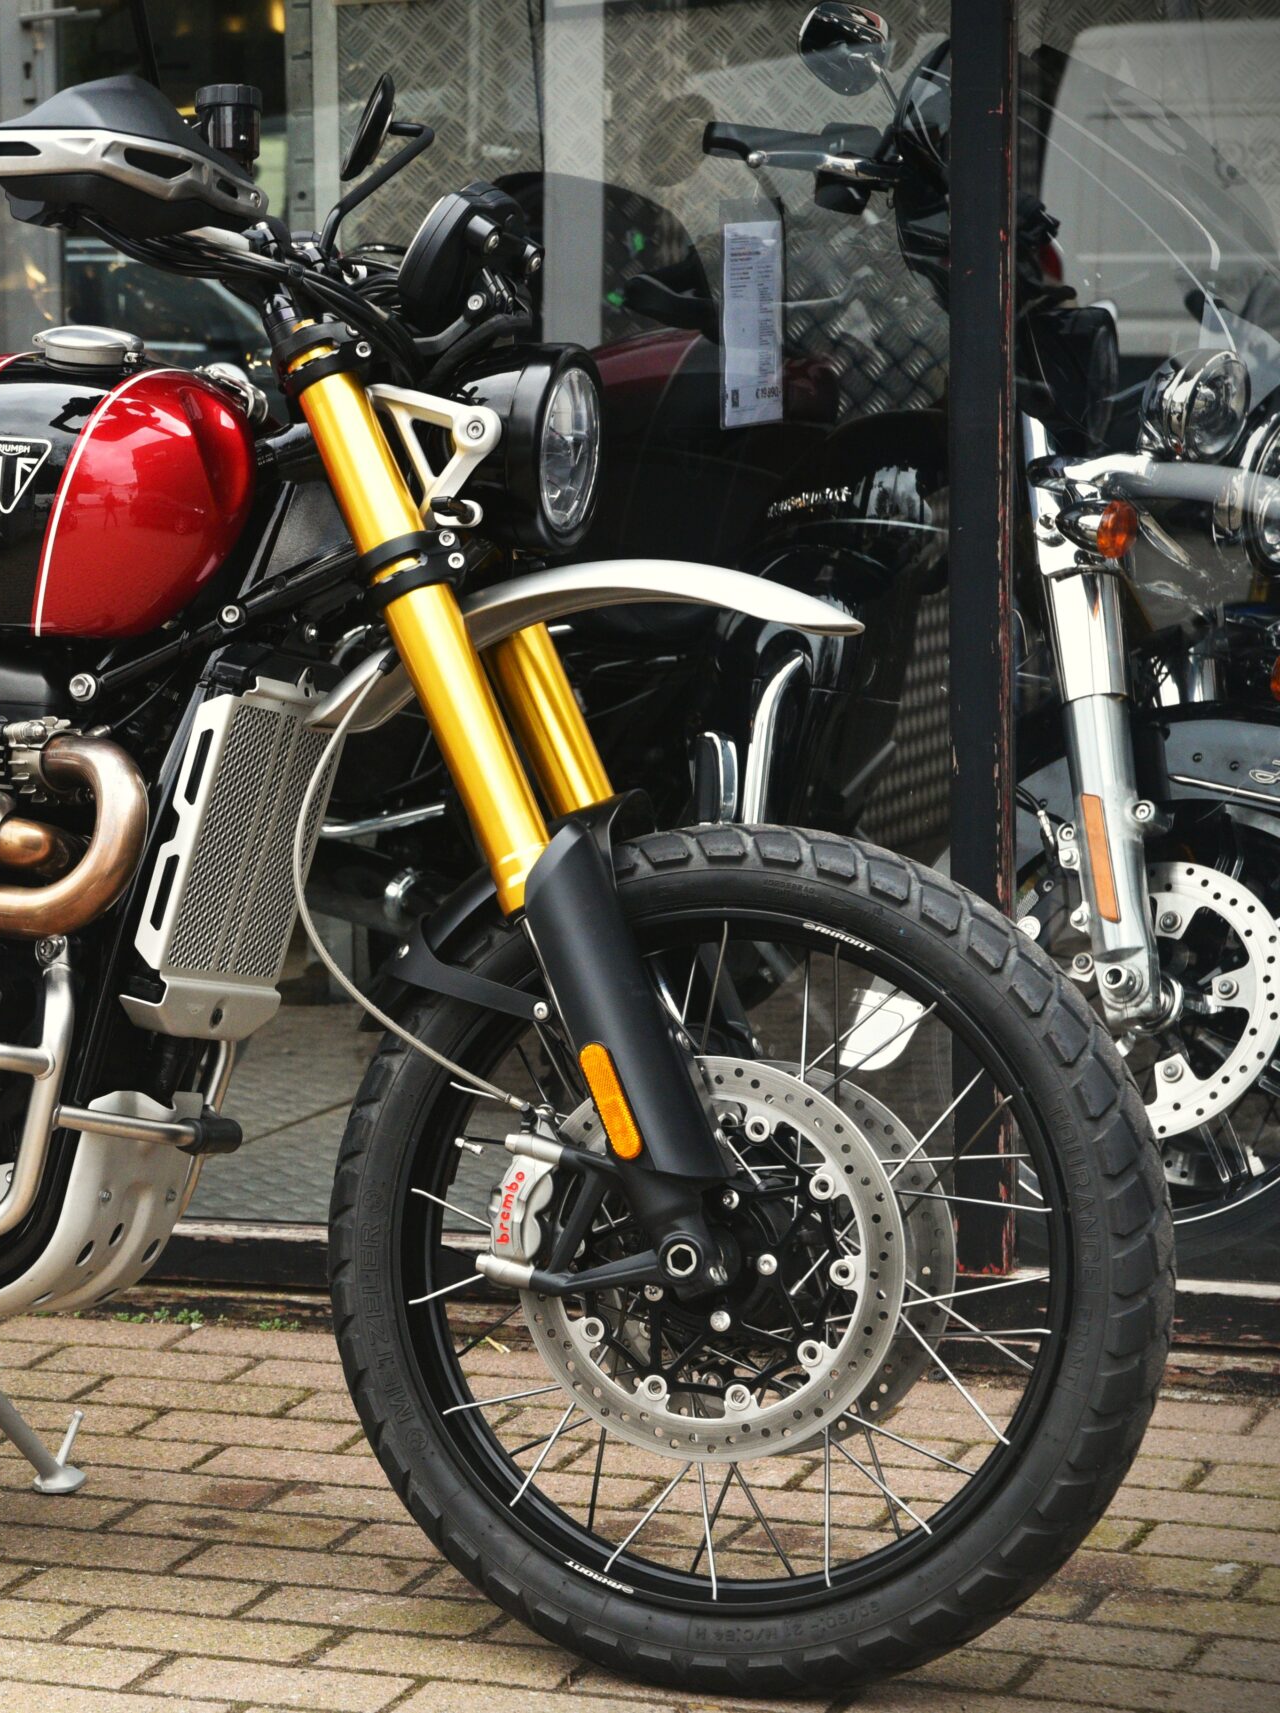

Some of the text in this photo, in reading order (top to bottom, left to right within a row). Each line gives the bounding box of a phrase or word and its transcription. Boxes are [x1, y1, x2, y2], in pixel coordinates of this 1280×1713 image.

[495, 1170, 527, 1245] brembo
[1048, 1099, 1102, 1393] TOURANCE FRONT
[360, 1222, 415, 1424] METZELER
[784, 1623, 804, 1638] 21
